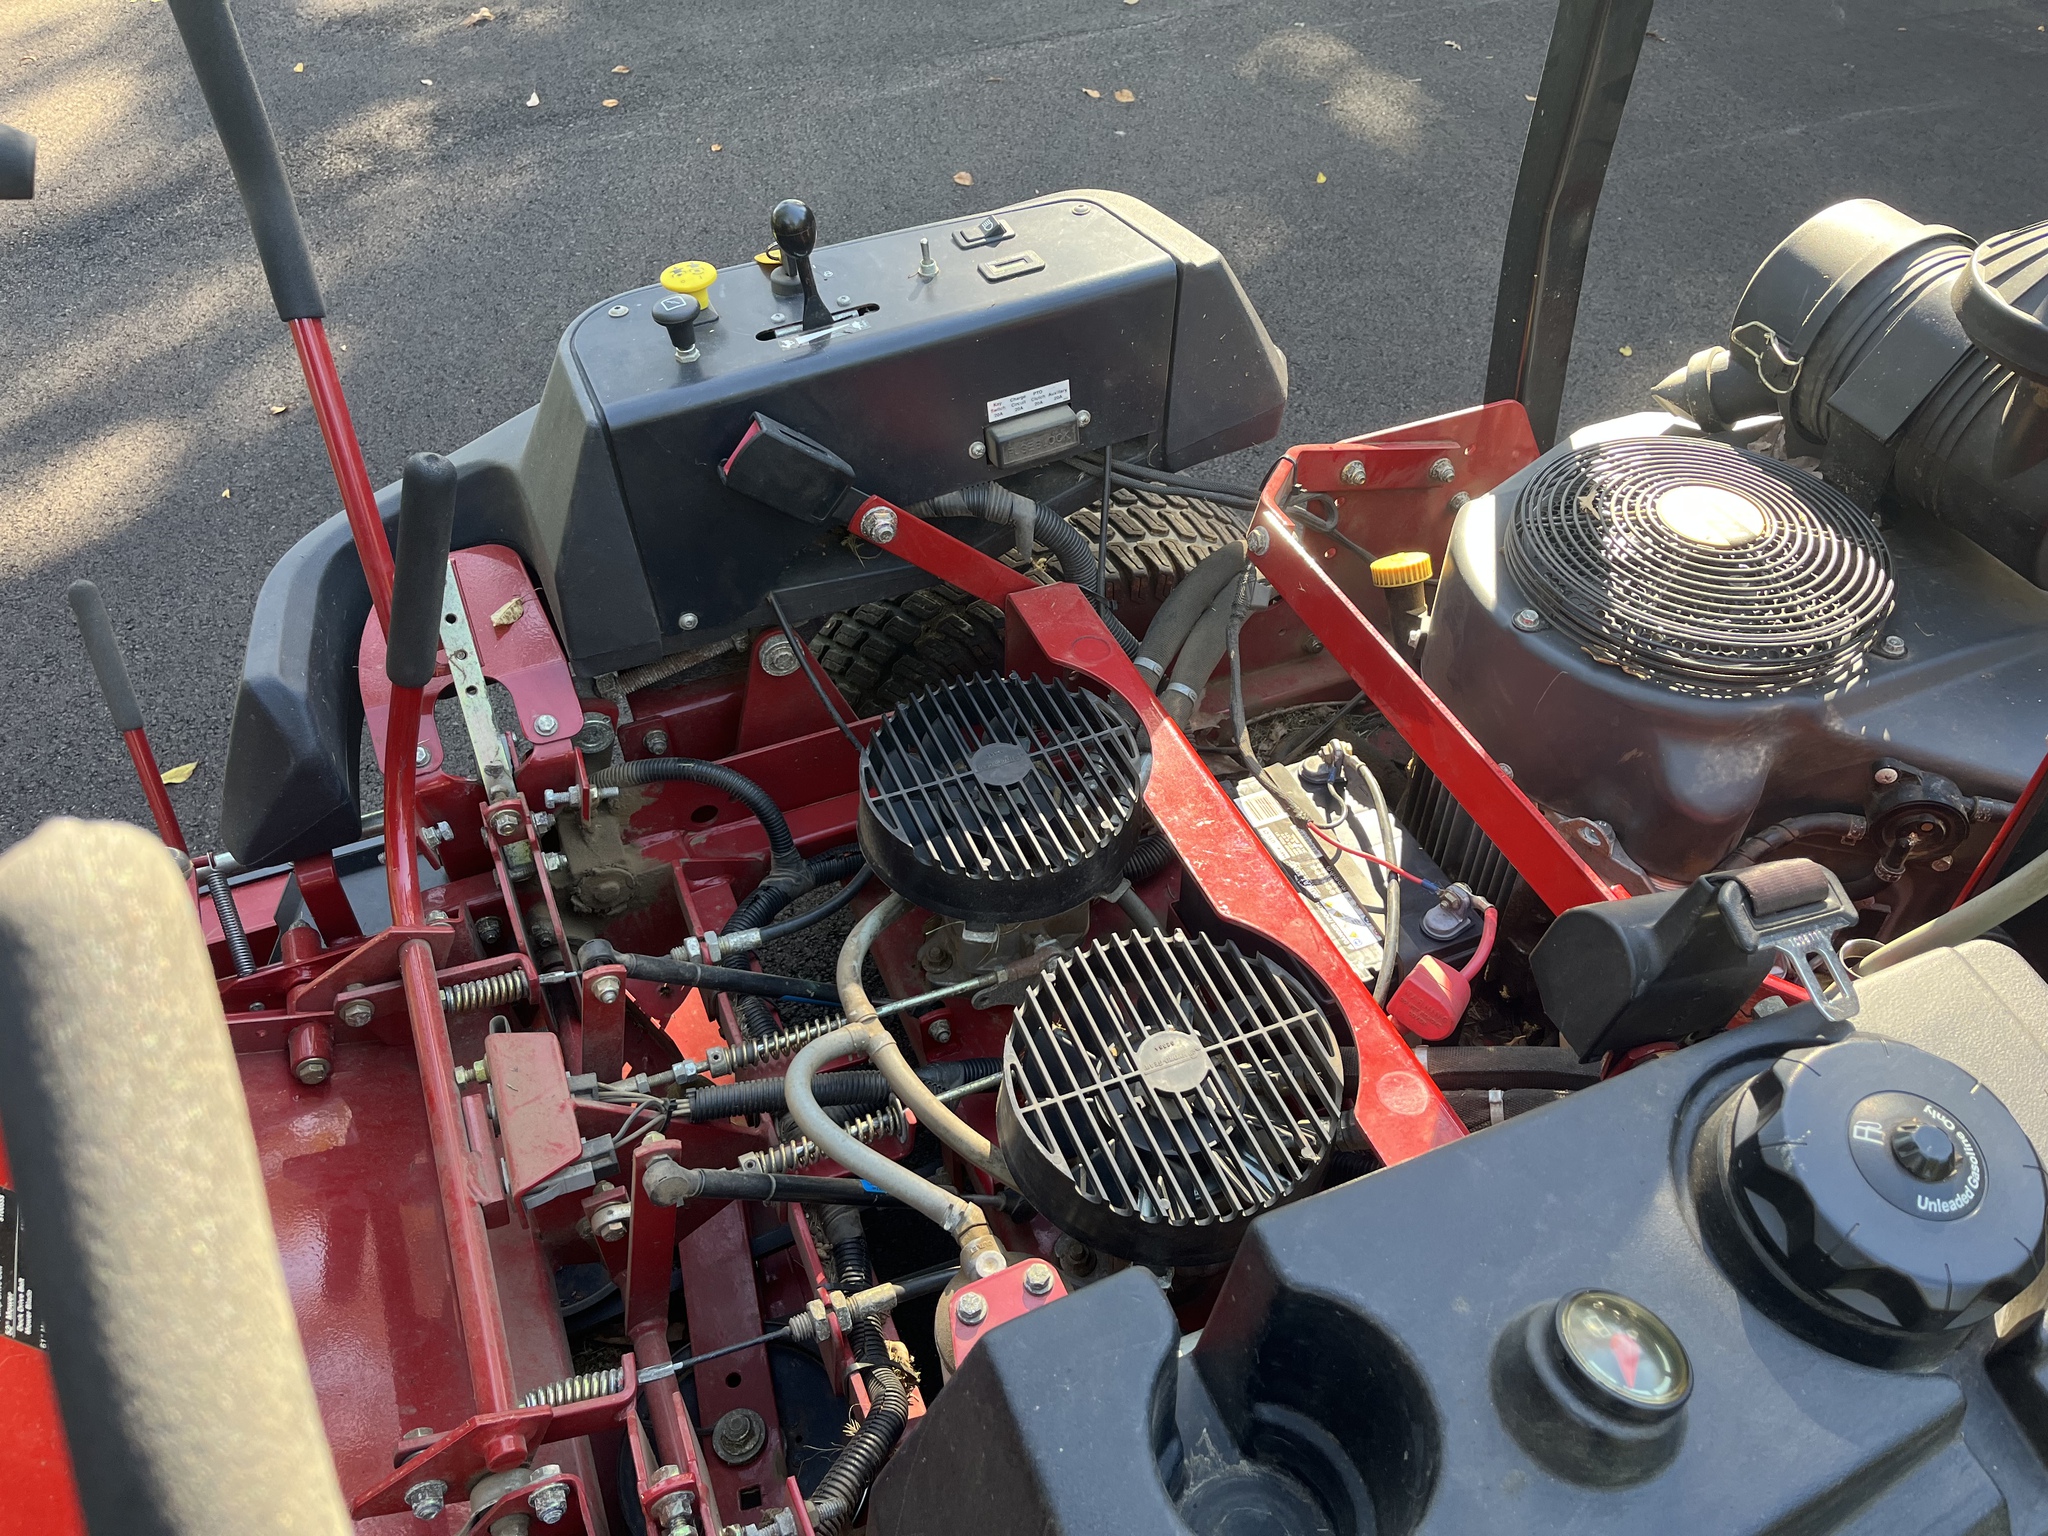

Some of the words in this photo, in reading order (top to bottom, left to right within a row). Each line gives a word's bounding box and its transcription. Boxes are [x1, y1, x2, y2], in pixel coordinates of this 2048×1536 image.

[1009, 394, 1027, 402] Charge
[1923, 1104, 1956, 1131] Only
[1955, 1131, 1980, 1190] Gasoline
[1916, 1185, 1975, 1212] Unleaded
